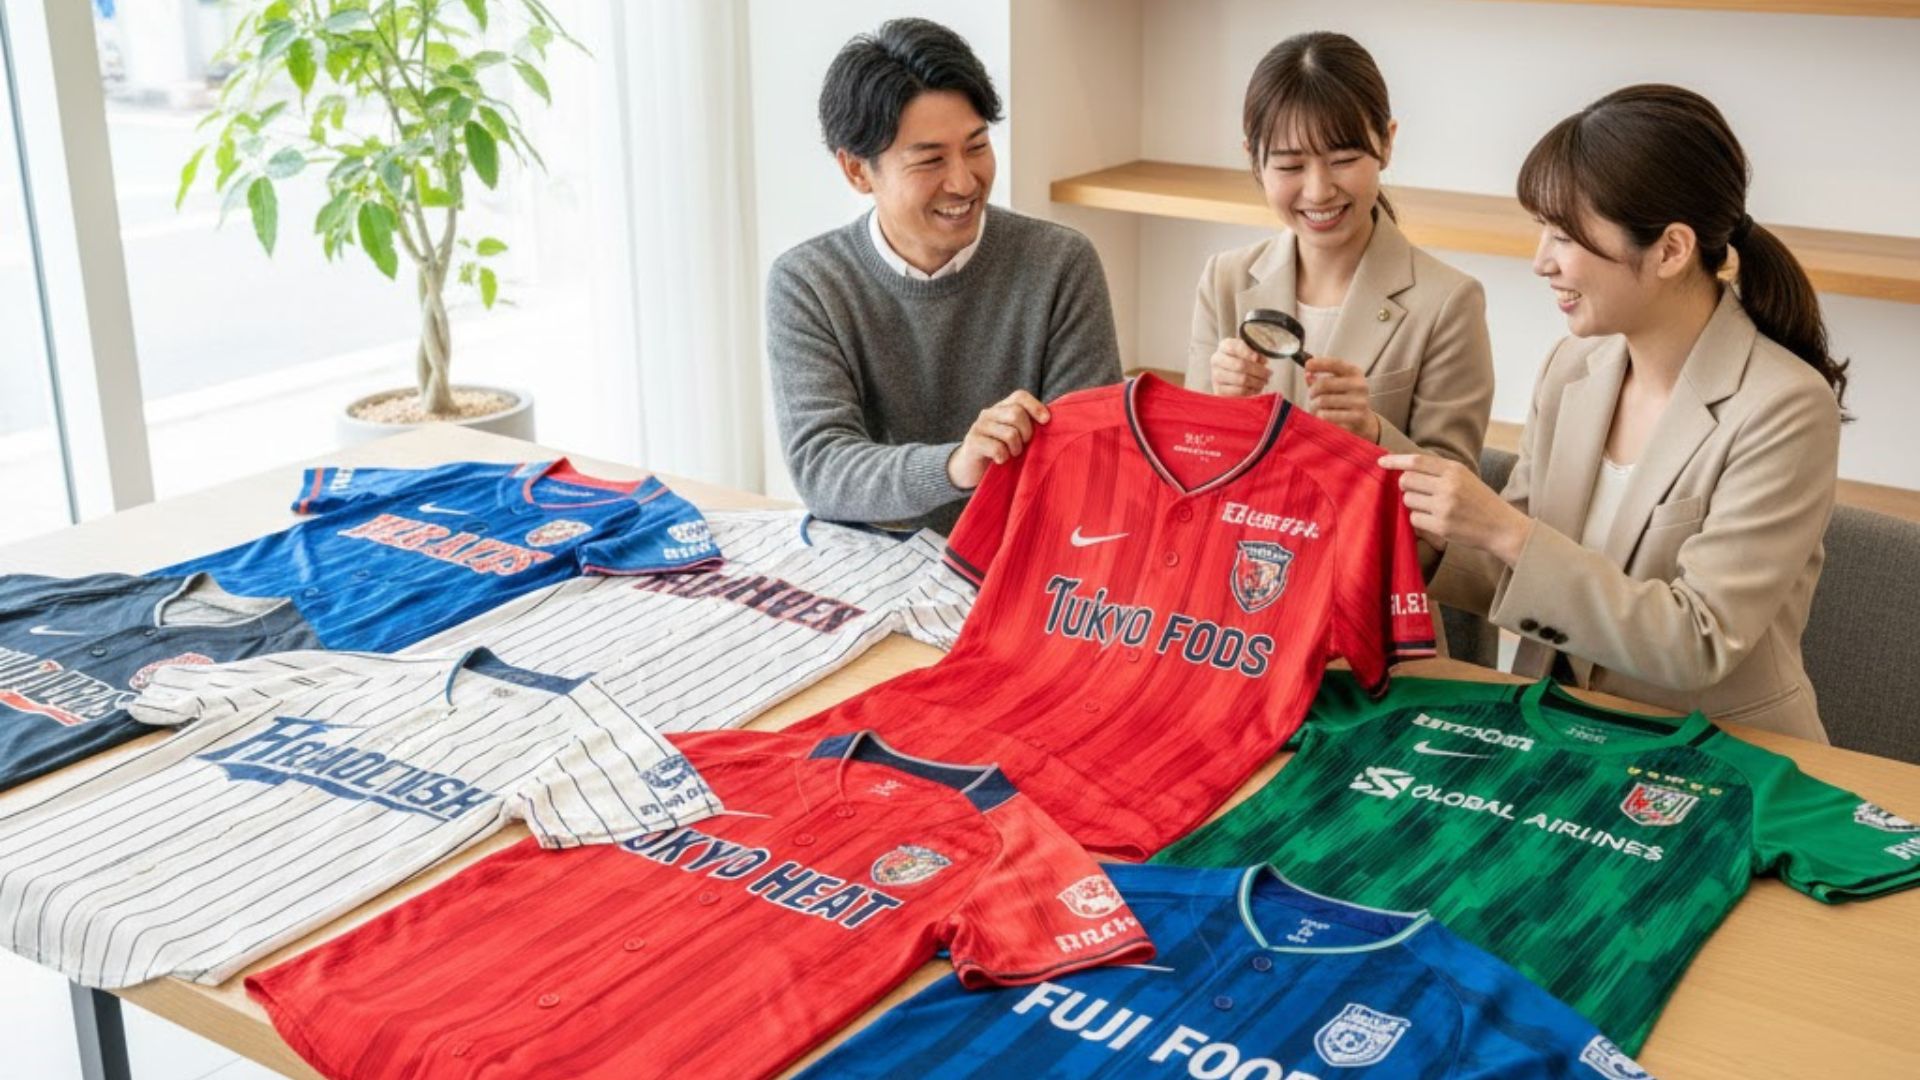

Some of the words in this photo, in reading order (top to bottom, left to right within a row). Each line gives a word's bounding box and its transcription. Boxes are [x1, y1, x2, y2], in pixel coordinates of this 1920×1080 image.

[1156, 613, 1275, 679] FODS
[1523, 813, 1664, 861] AIRLINES
[747, 860, 905, 930] HEAT
[1012, 981, 1153, 1050] FUJI
[1148, 1024, 1321, 1080] FOO
